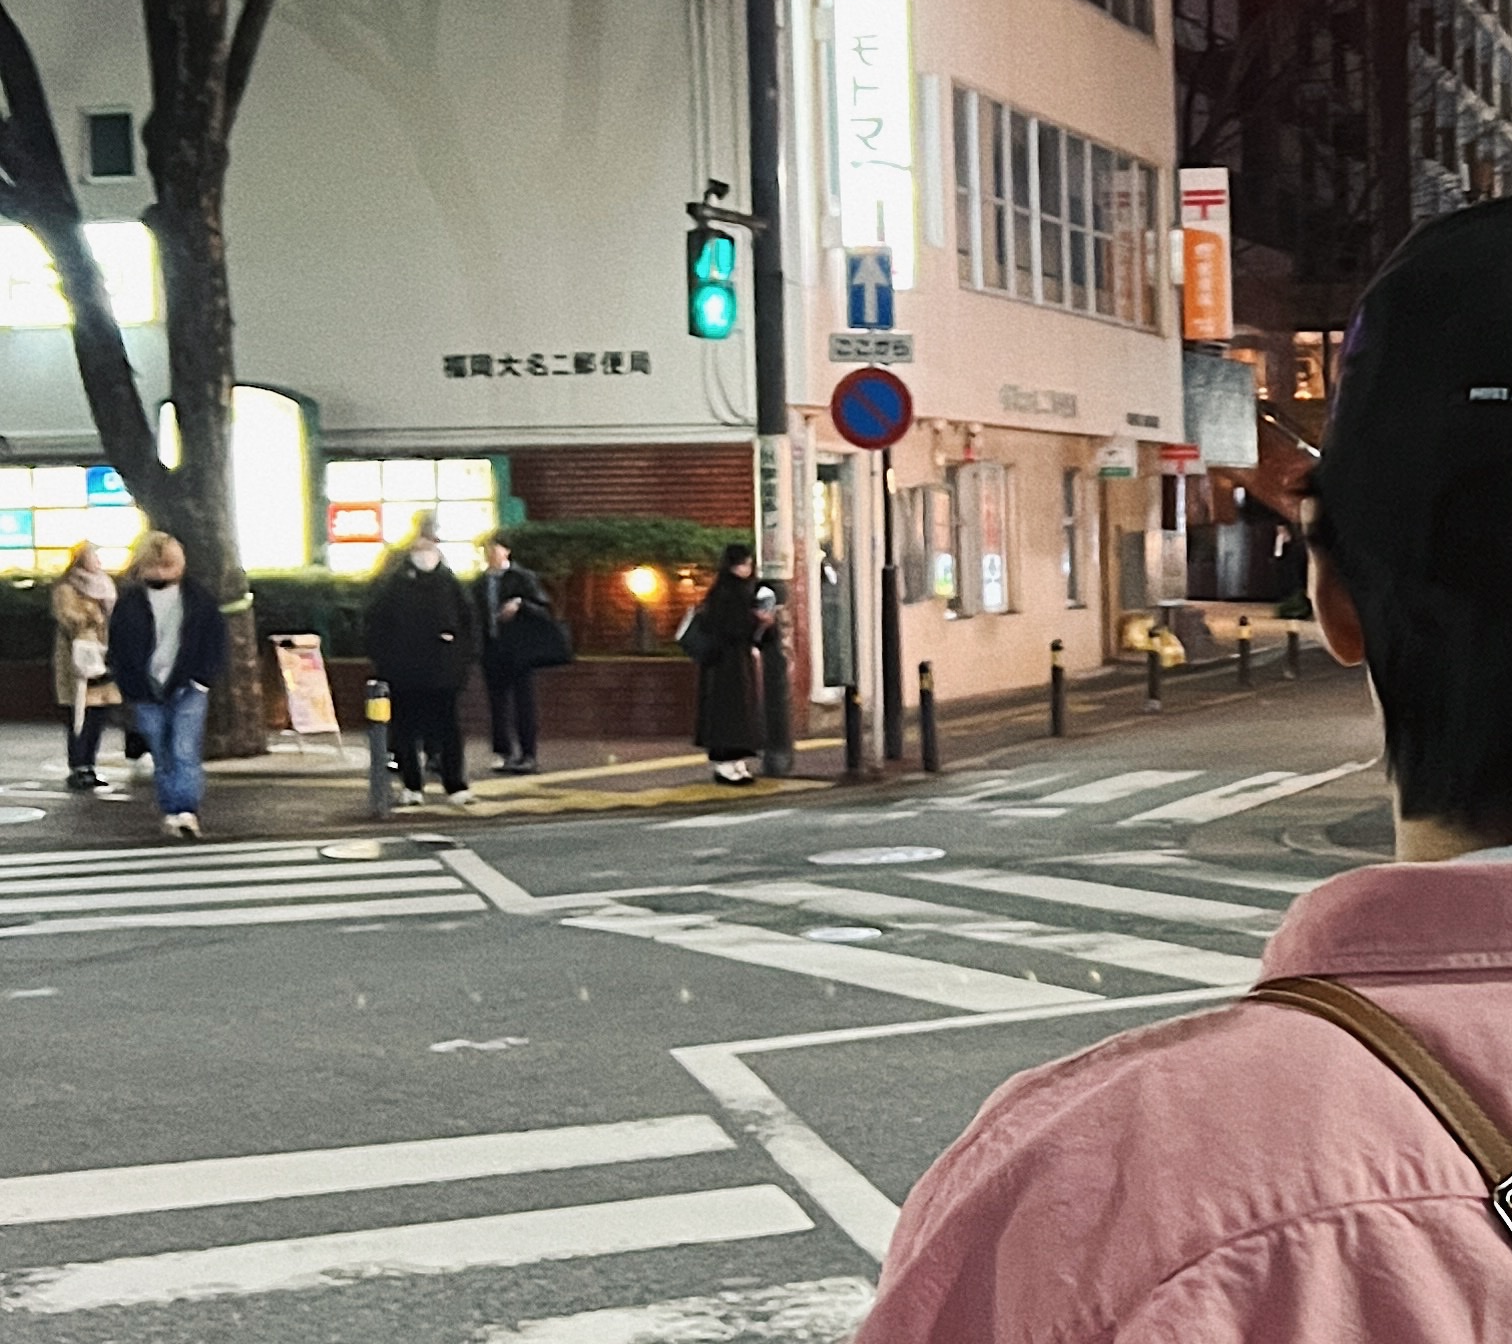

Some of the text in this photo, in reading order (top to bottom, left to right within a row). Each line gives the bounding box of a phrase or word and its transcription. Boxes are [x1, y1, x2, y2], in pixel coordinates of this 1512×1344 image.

[835, 337, 910, 357] ここから
[443, 349, 652, 378] 福岡大名二郵便局
